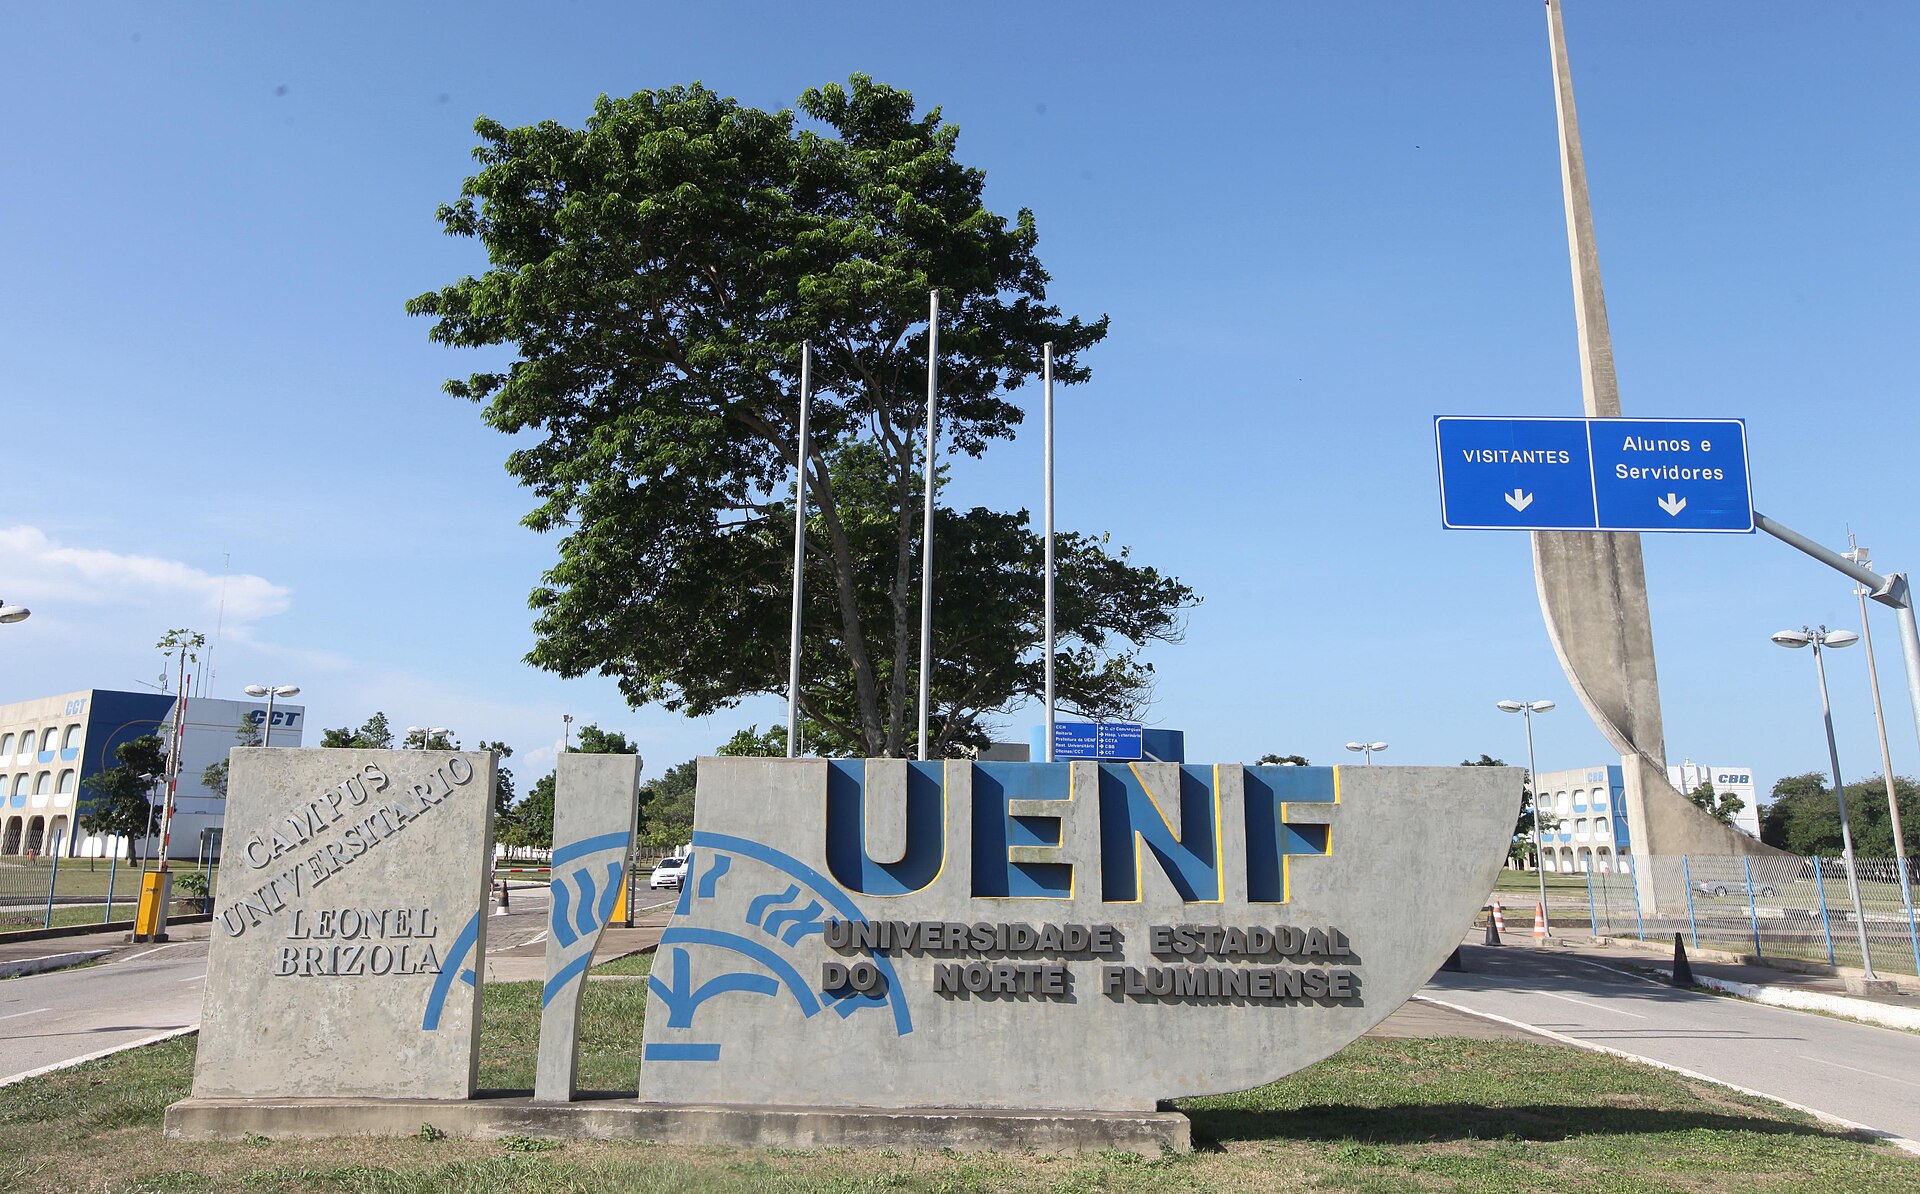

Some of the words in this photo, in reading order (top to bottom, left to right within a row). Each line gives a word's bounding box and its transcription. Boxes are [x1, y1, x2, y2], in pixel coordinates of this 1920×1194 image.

[1623, 436, 1690, 452] Alunos
[1701, 439, 1711, 452] e
[1463, 449, 1570, 464] VISITANTES
[1616, 464, 1724, 481] Servidores
[65, 698, 87, 716] CCT
[250, 709, 300, 726] CCT
[1587, 772, 1604, 782] CBB
[1718, 774, 1749, 783] CBB
[245, 761, 390, 869] CAMPUS
[825, 760, 1340, 904] UENF
[287, 908, 437, 939] LEONEL
[824, 919, 1115, 953] UNIVERSIDADE
[1150, 925, 1350, 956] ESTADUAL
[275, 943, 443, 977] BRIZOLA
[822, 960, 878, 992] DO
[933, 962, 1064, 994] NORTE
[1102, 966, 1352, 997] FLUMINENSE
